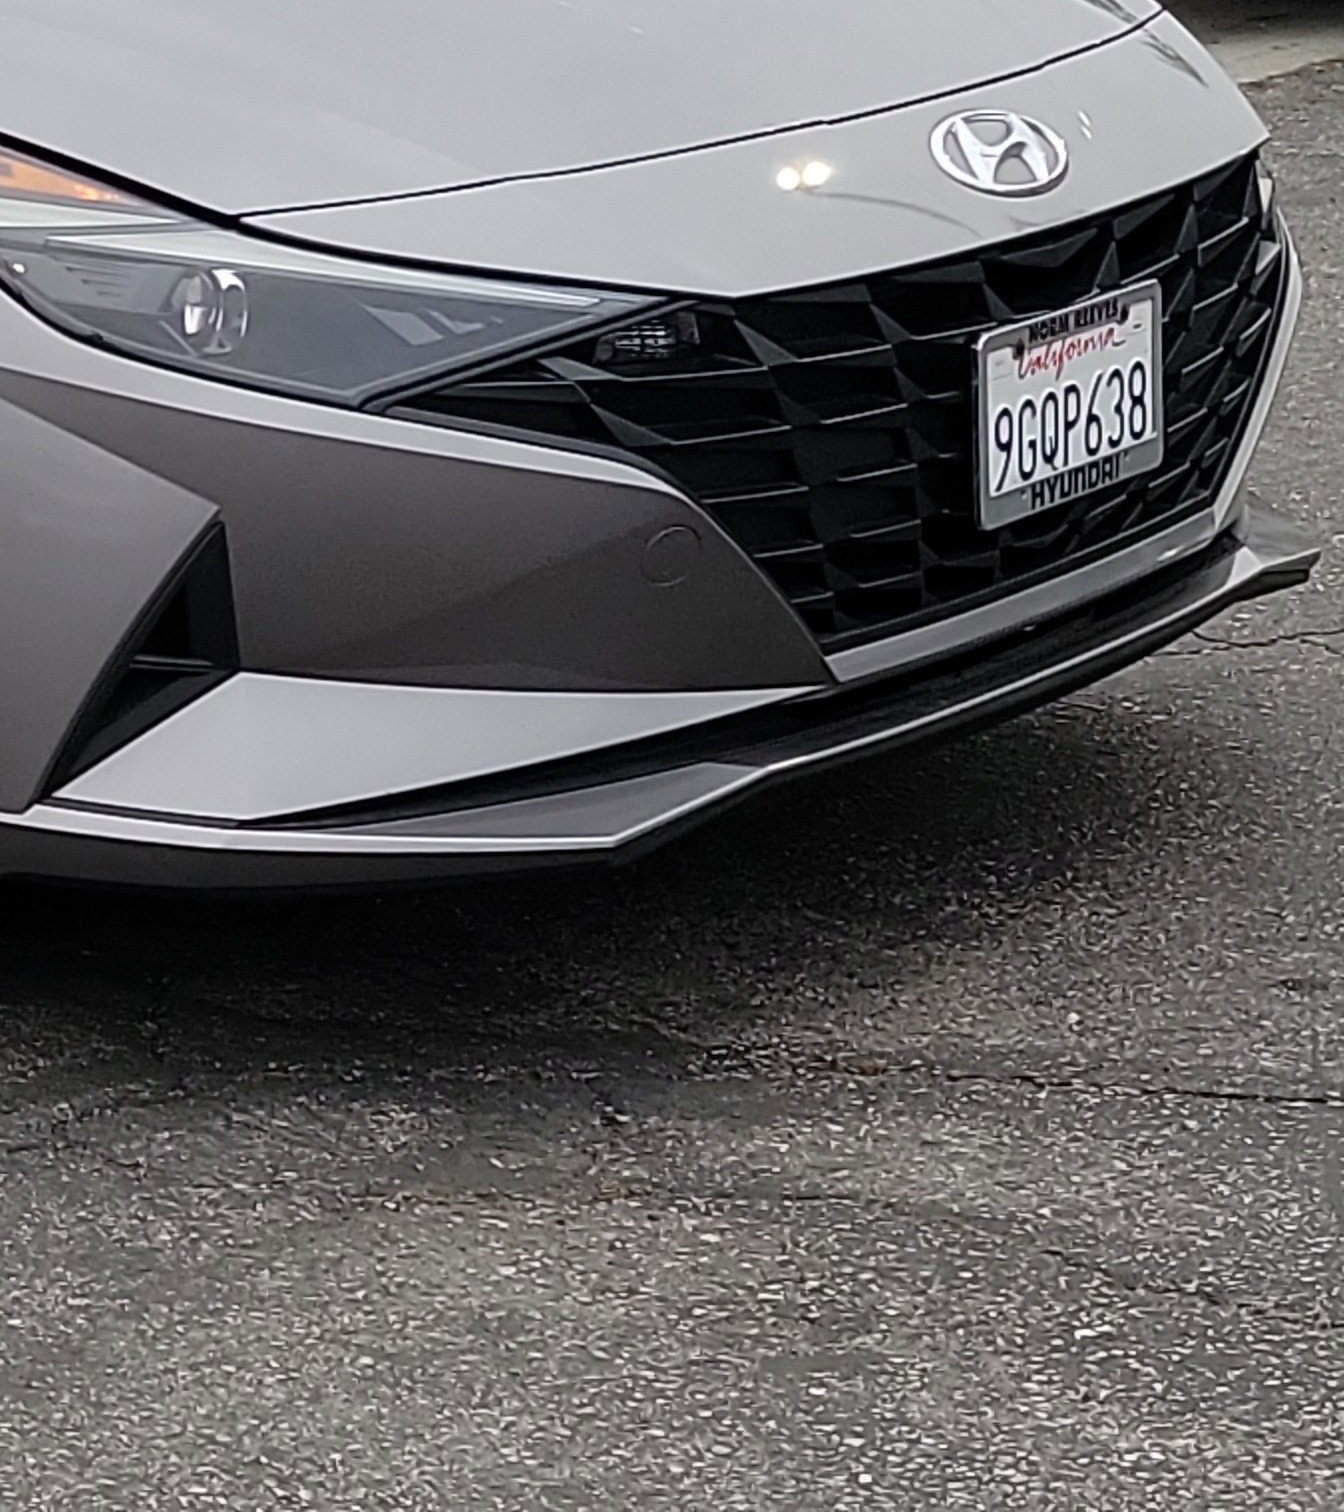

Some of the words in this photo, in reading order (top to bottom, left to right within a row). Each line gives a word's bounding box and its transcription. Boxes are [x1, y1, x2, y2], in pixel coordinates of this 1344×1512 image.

[1017, 326, 1127, 382] California
[994, 360, 1147, 493] 9GQP638
[1031, 455, 1121, 510] HYUNDAI
